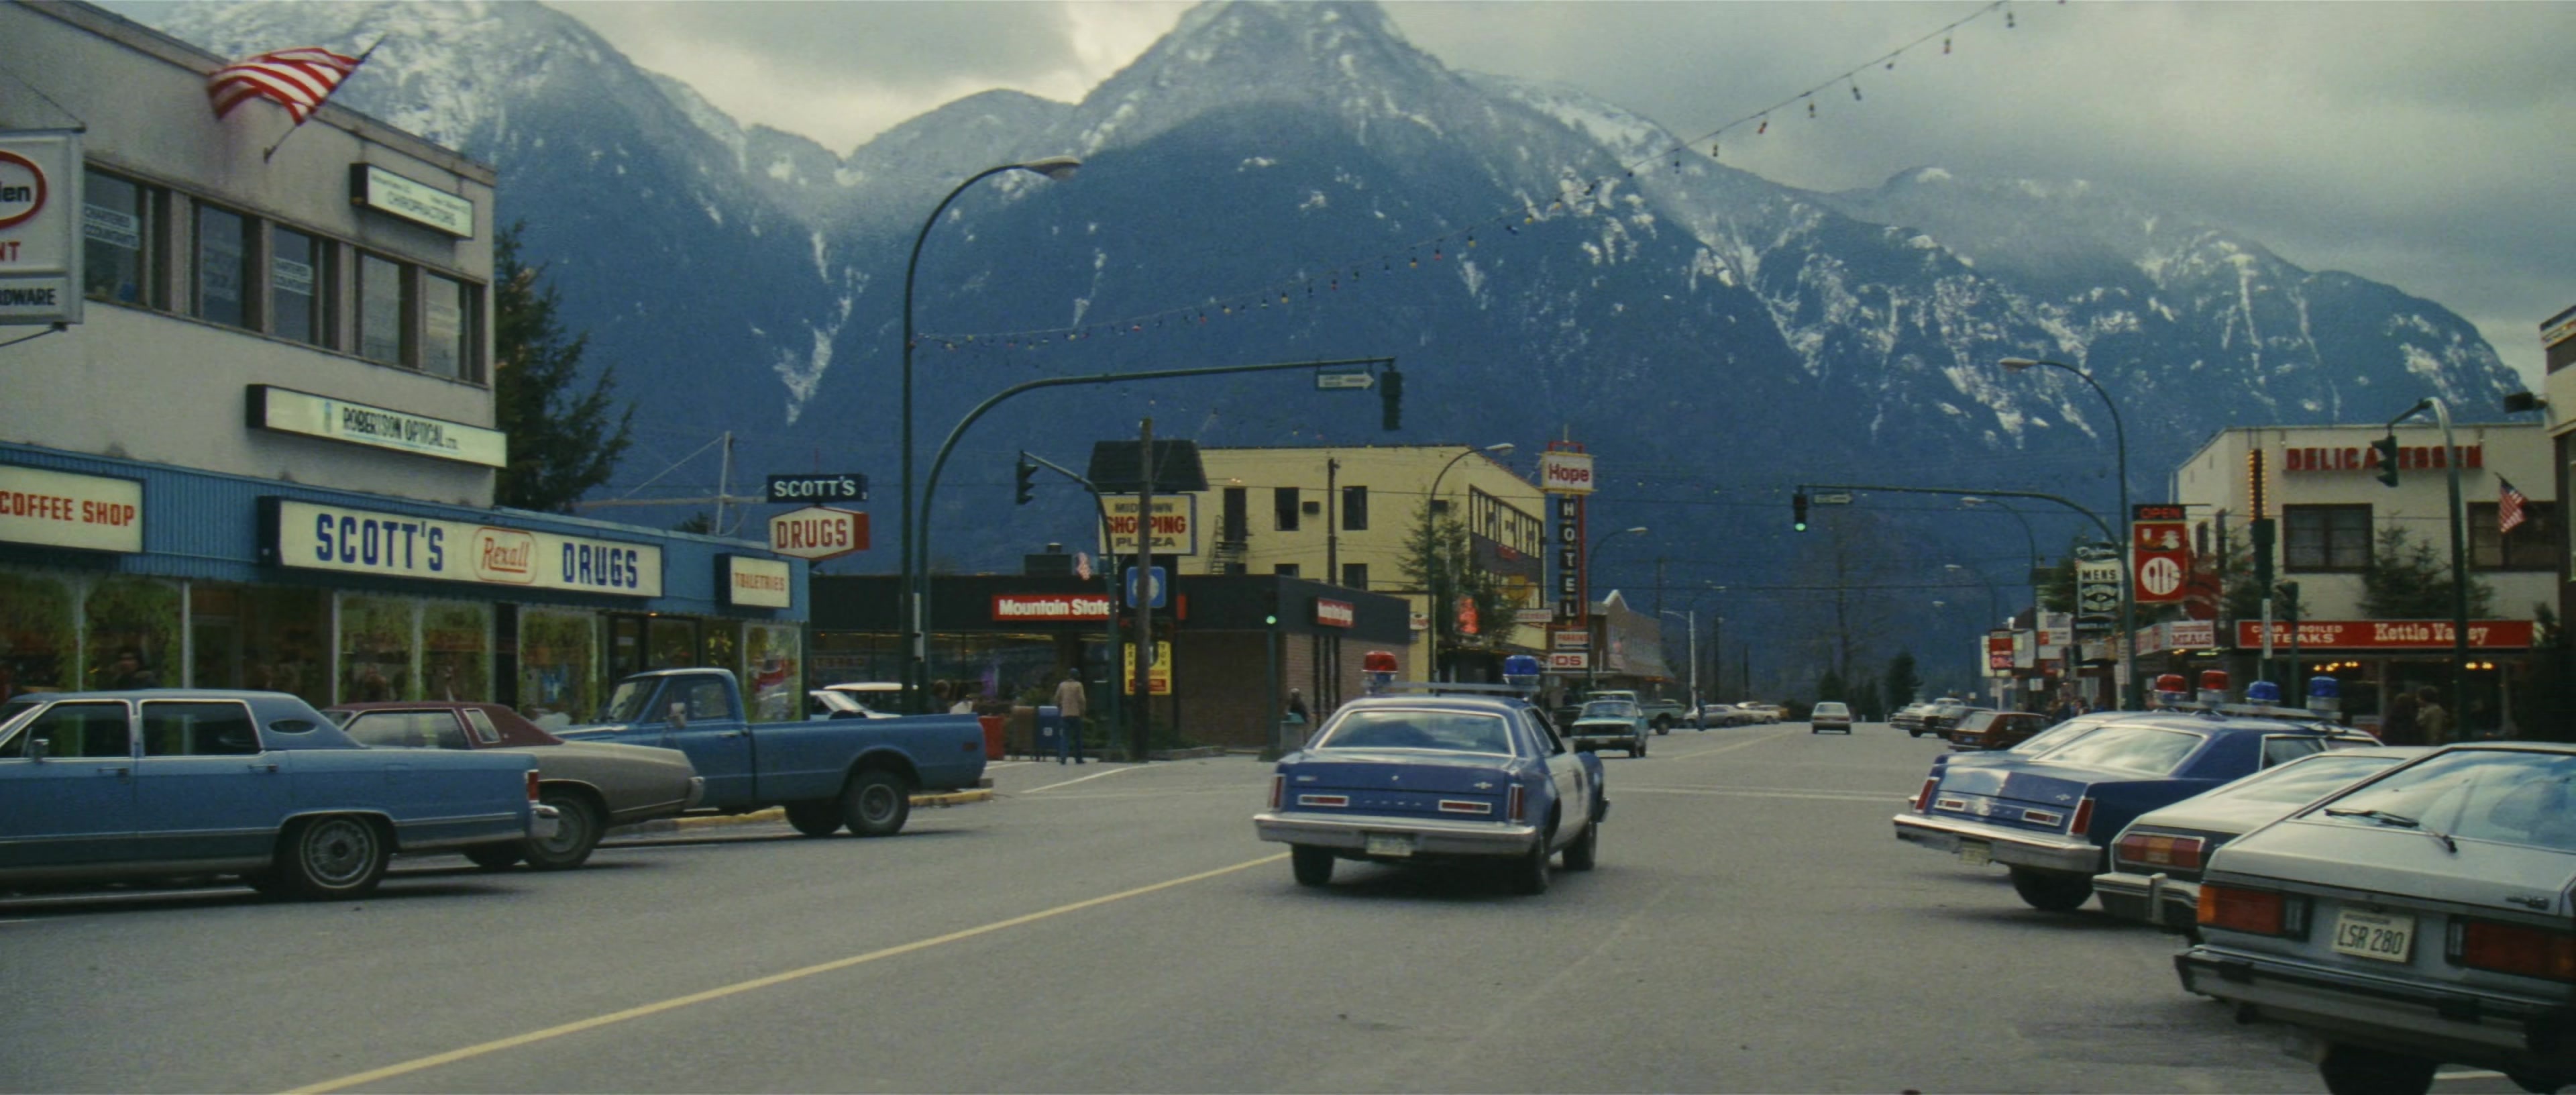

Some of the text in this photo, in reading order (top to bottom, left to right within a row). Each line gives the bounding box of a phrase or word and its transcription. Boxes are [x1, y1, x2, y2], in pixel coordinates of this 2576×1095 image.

[343, 407, 402, 440] ROBERTSON
[405, 419, 444, 448] OPTICAL
[2286, 445, 2482, 470] DELICAESSEN
[1548, 462, 1590, 484] Hope
[773, 475, 857, 498] SCOTT'S
[0, 490, 135, 527] COFFEE SHOP
[1115, 503, 1173, 513] MIDWN
[2140, 507, 2181, 519] OPEN
[776, 518, 848, 551] DRUGS
[1107, 515, 1186, 534] SHOPING
[315, 513, 444, 572] SCOTT'S
[1116, 537, 1176, 548] PLZA
[481, 536, 529, 574] Rexall
[561, 542, 638, 589] DRUGS
[1563, 502, 1576, 617] HOTEL
[733, 572, 786, 592] TOILETRIES
[2082, 569, 2116, 580] MENS
[998, 598, 1120, 615] Mountain State
[2171, 634, 2213, 645] MEALS
[2251, 625, 2284, 633] CAR
[2259, 633, 2335, 643] TEAKS
[2373, 623, 2489, 646] Kettle Vaey
[2337, 923, 2404, 955] LSR 280
